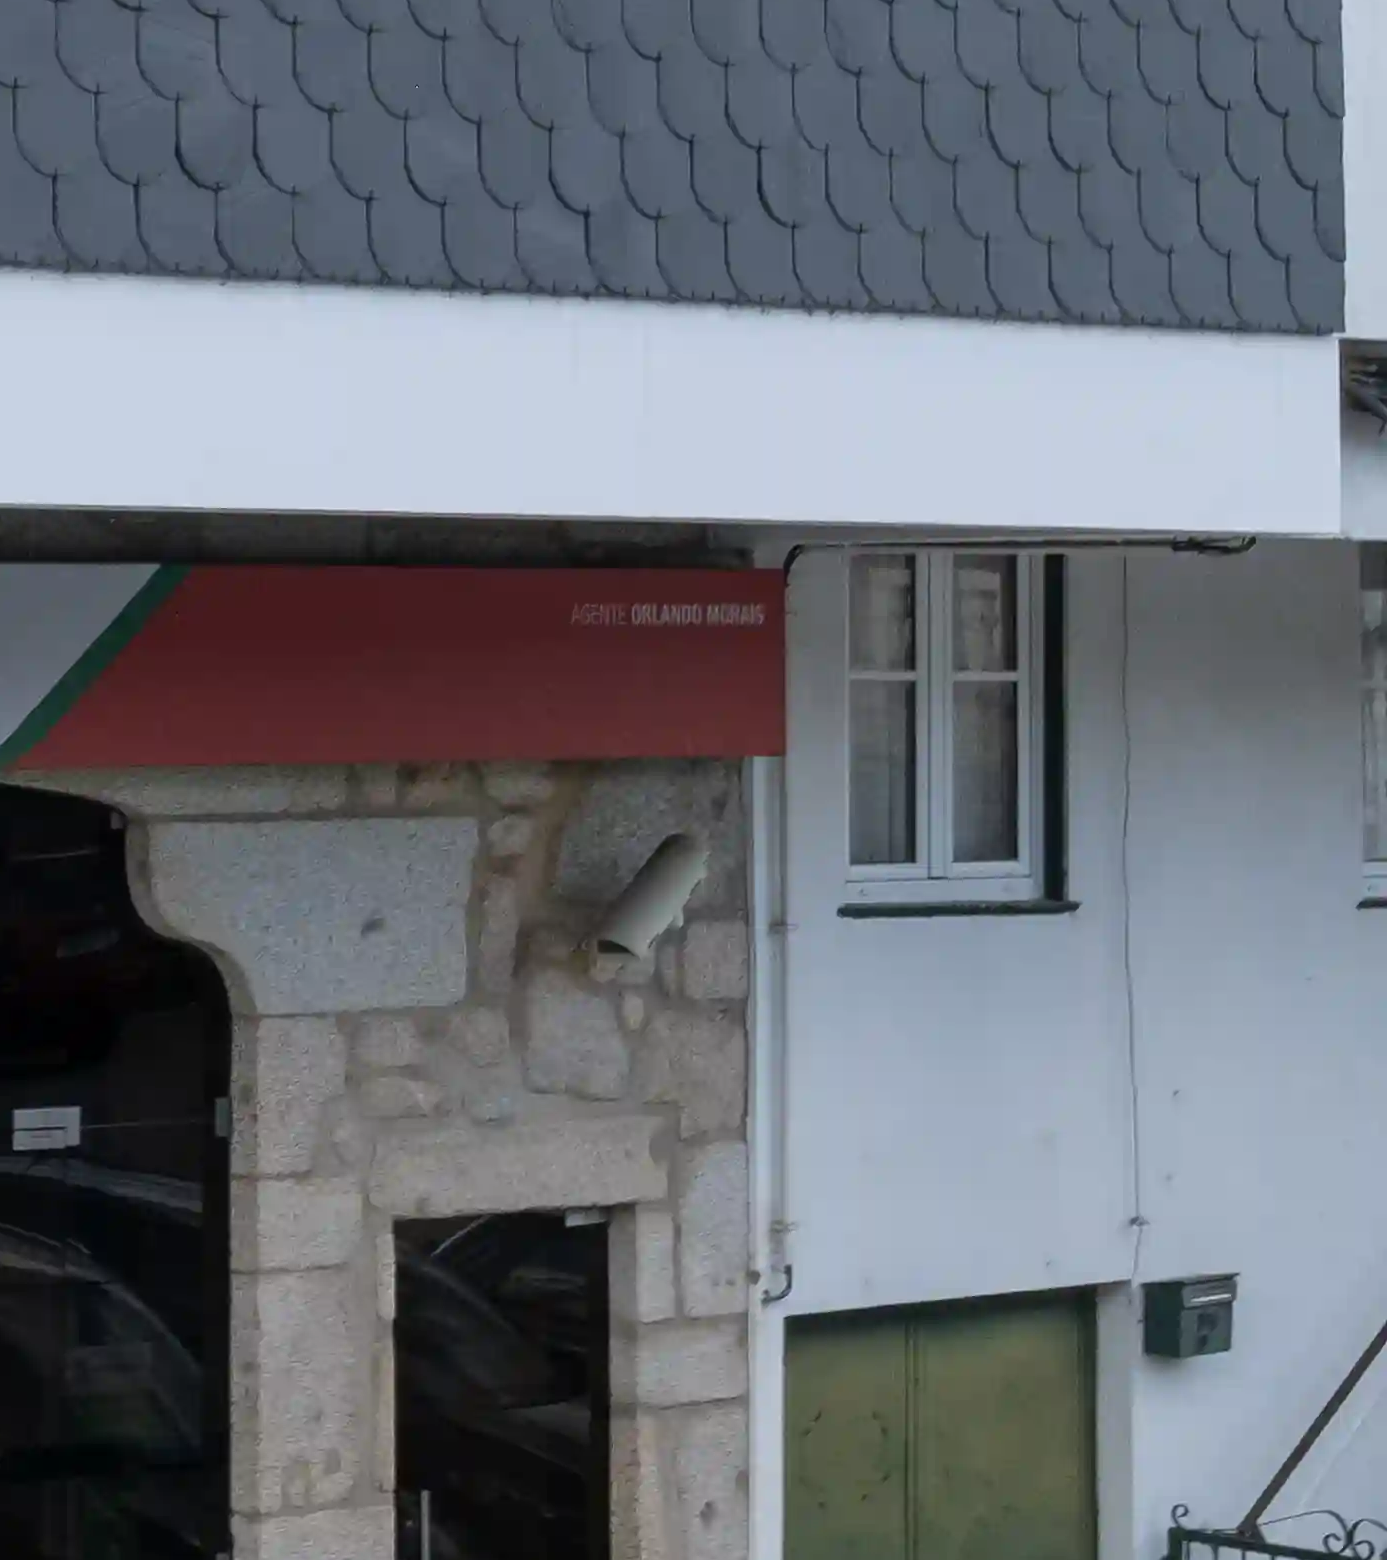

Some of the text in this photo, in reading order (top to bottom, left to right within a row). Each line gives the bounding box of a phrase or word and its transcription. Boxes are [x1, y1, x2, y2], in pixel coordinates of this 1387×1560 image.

[570, 602, 767, 626] AGENTE ORLANDO MORAIS
